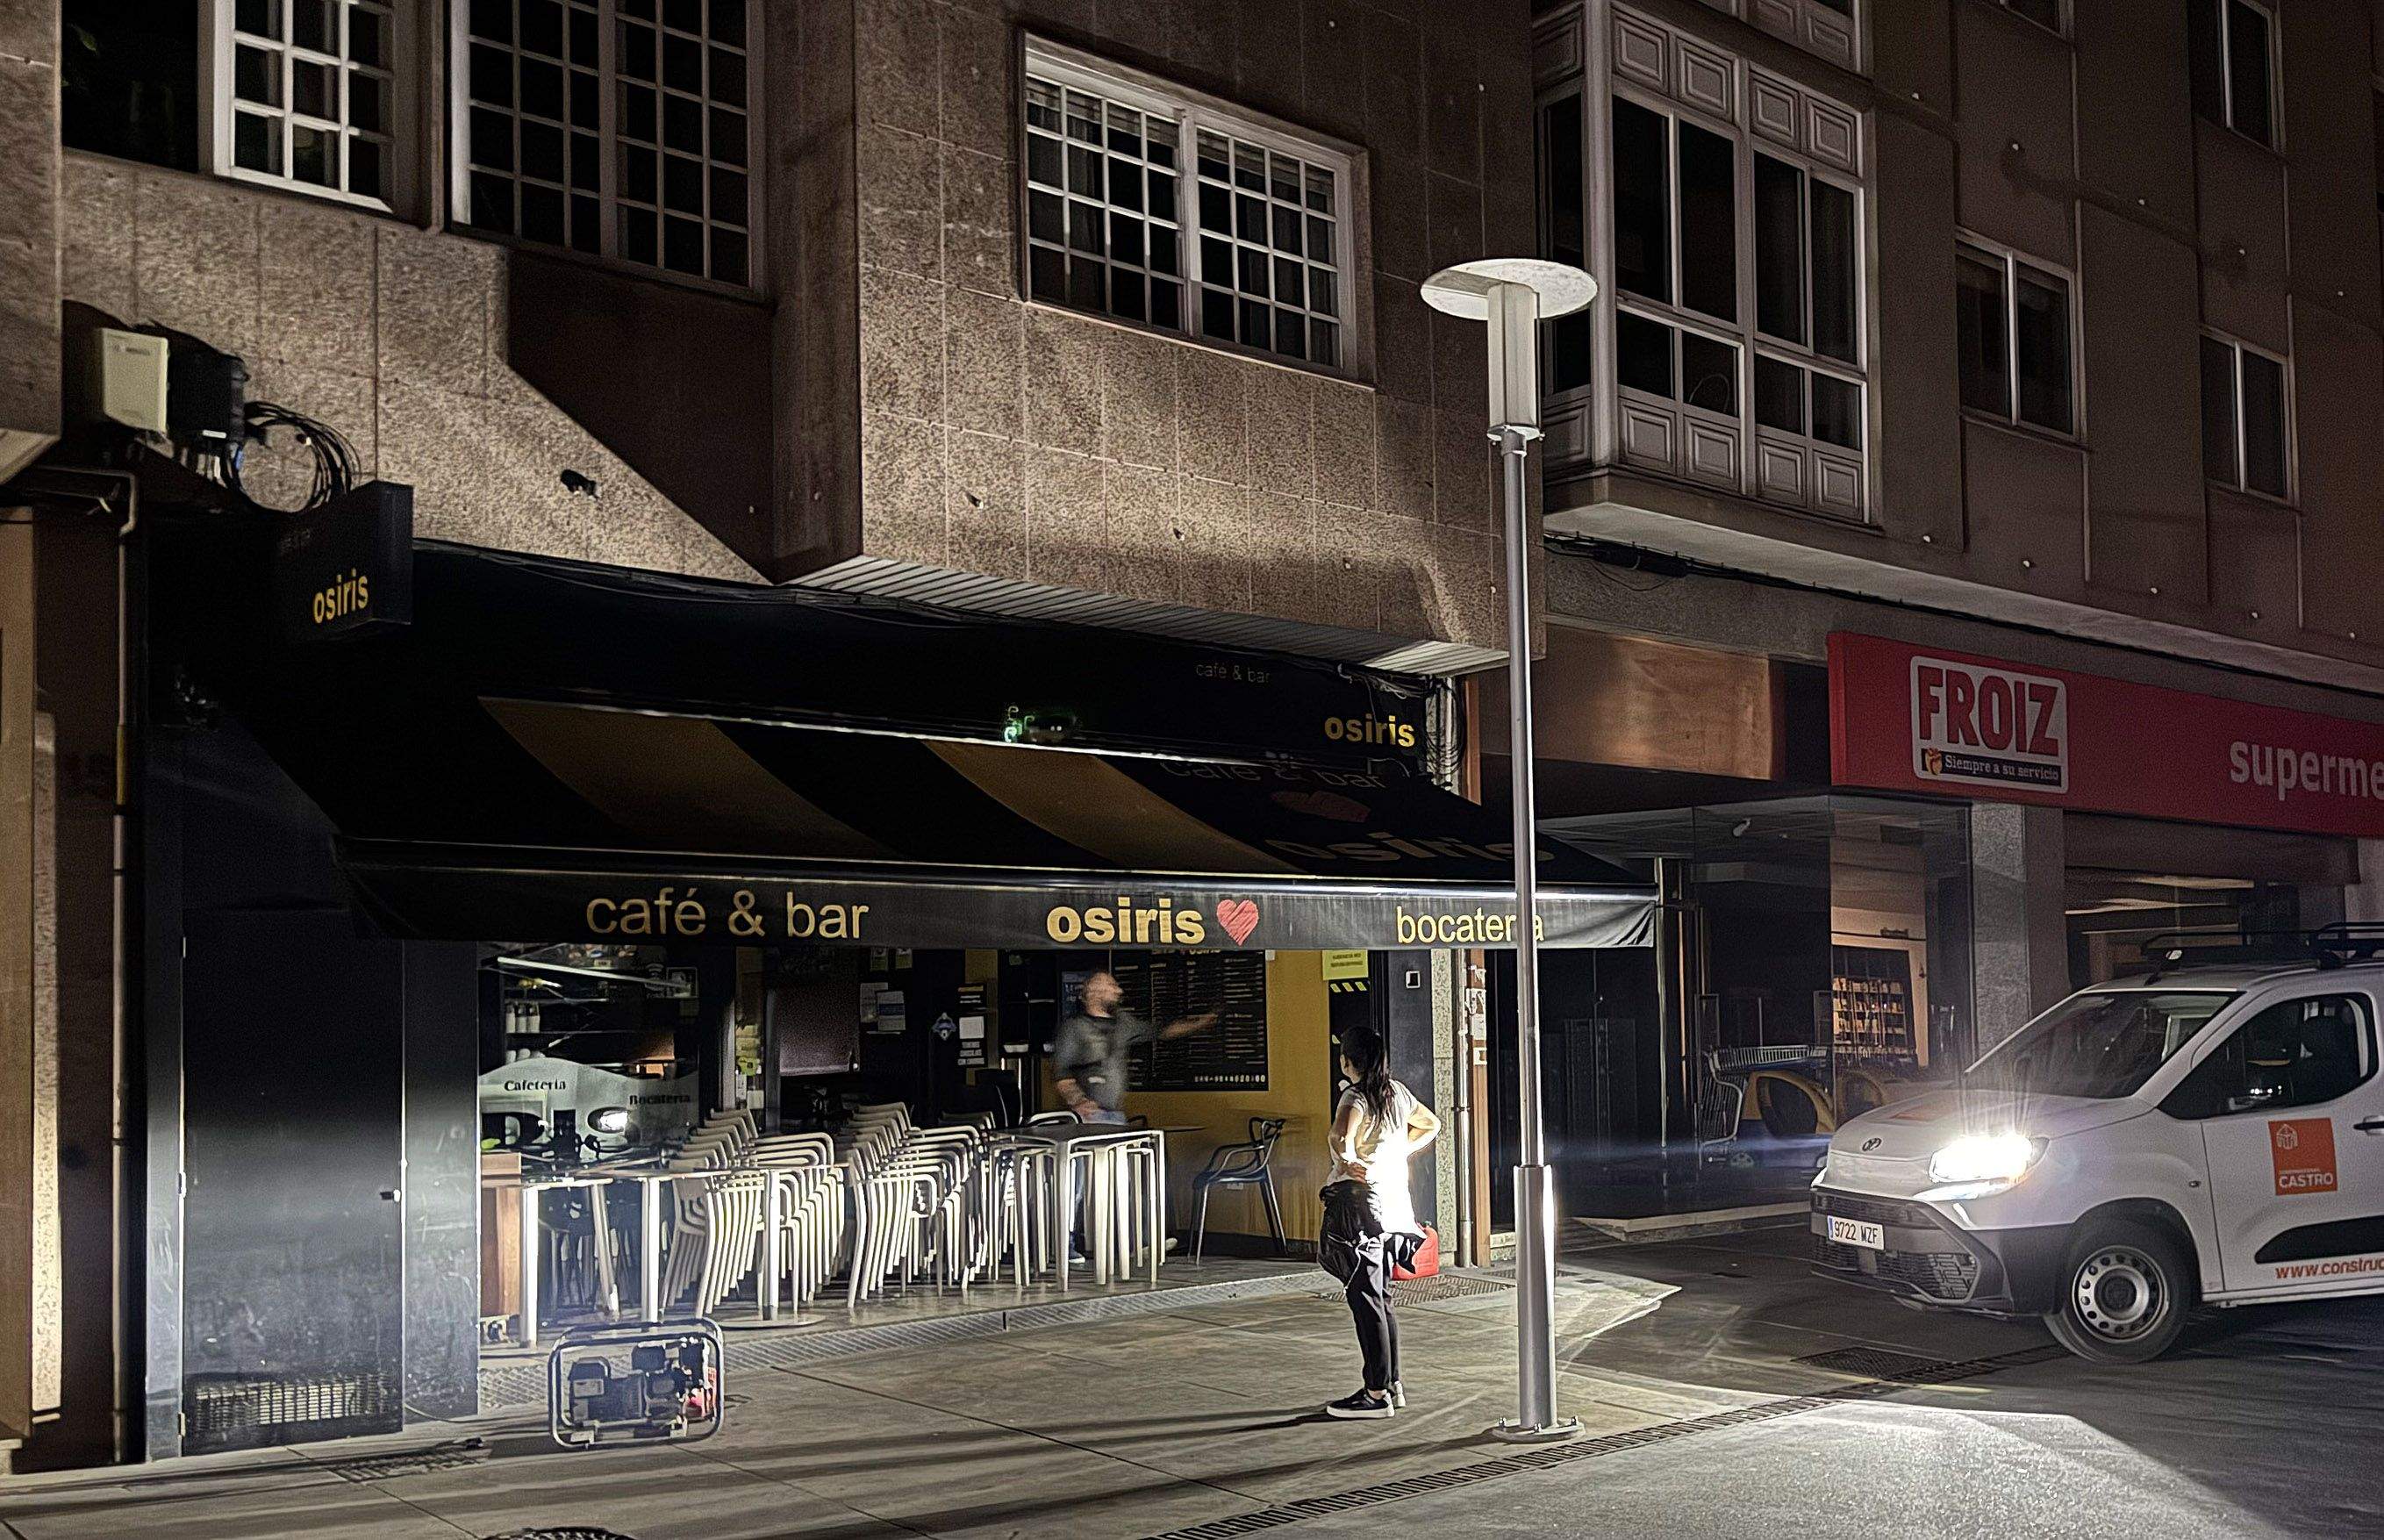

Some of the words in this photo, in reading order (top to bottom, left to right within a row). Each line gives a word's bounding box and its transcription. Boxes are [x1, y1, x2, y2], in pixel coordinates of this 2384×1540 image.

[312, 567, 369, 625] osiris
[1234, 665, 1242, 681] &
[1248, 666, 1271, 684] bar
[1918, 665, 2059, 756] FROIZ
[1324, 713, 1415, 748] osiris
[1944, 754, 1991, 774] Siempre
[1993, 763, 2001, 774] a
[2002, 764, 2015, 777] su
[2017, 766, 2059, 781] servicio
[2230, 741, 2384, 801] superme
[586, 887, 706, 936] café
[727, 890, 765, 937] &
[786, 892, 870, 939] bar
[1047, 896, 1206, 944] osiris
[1396, 906, 1545, 943] bocatera
[2279, 1172, 2333, 1188] CASTRO
[1834, 1221, 1857, 1241] 9722
